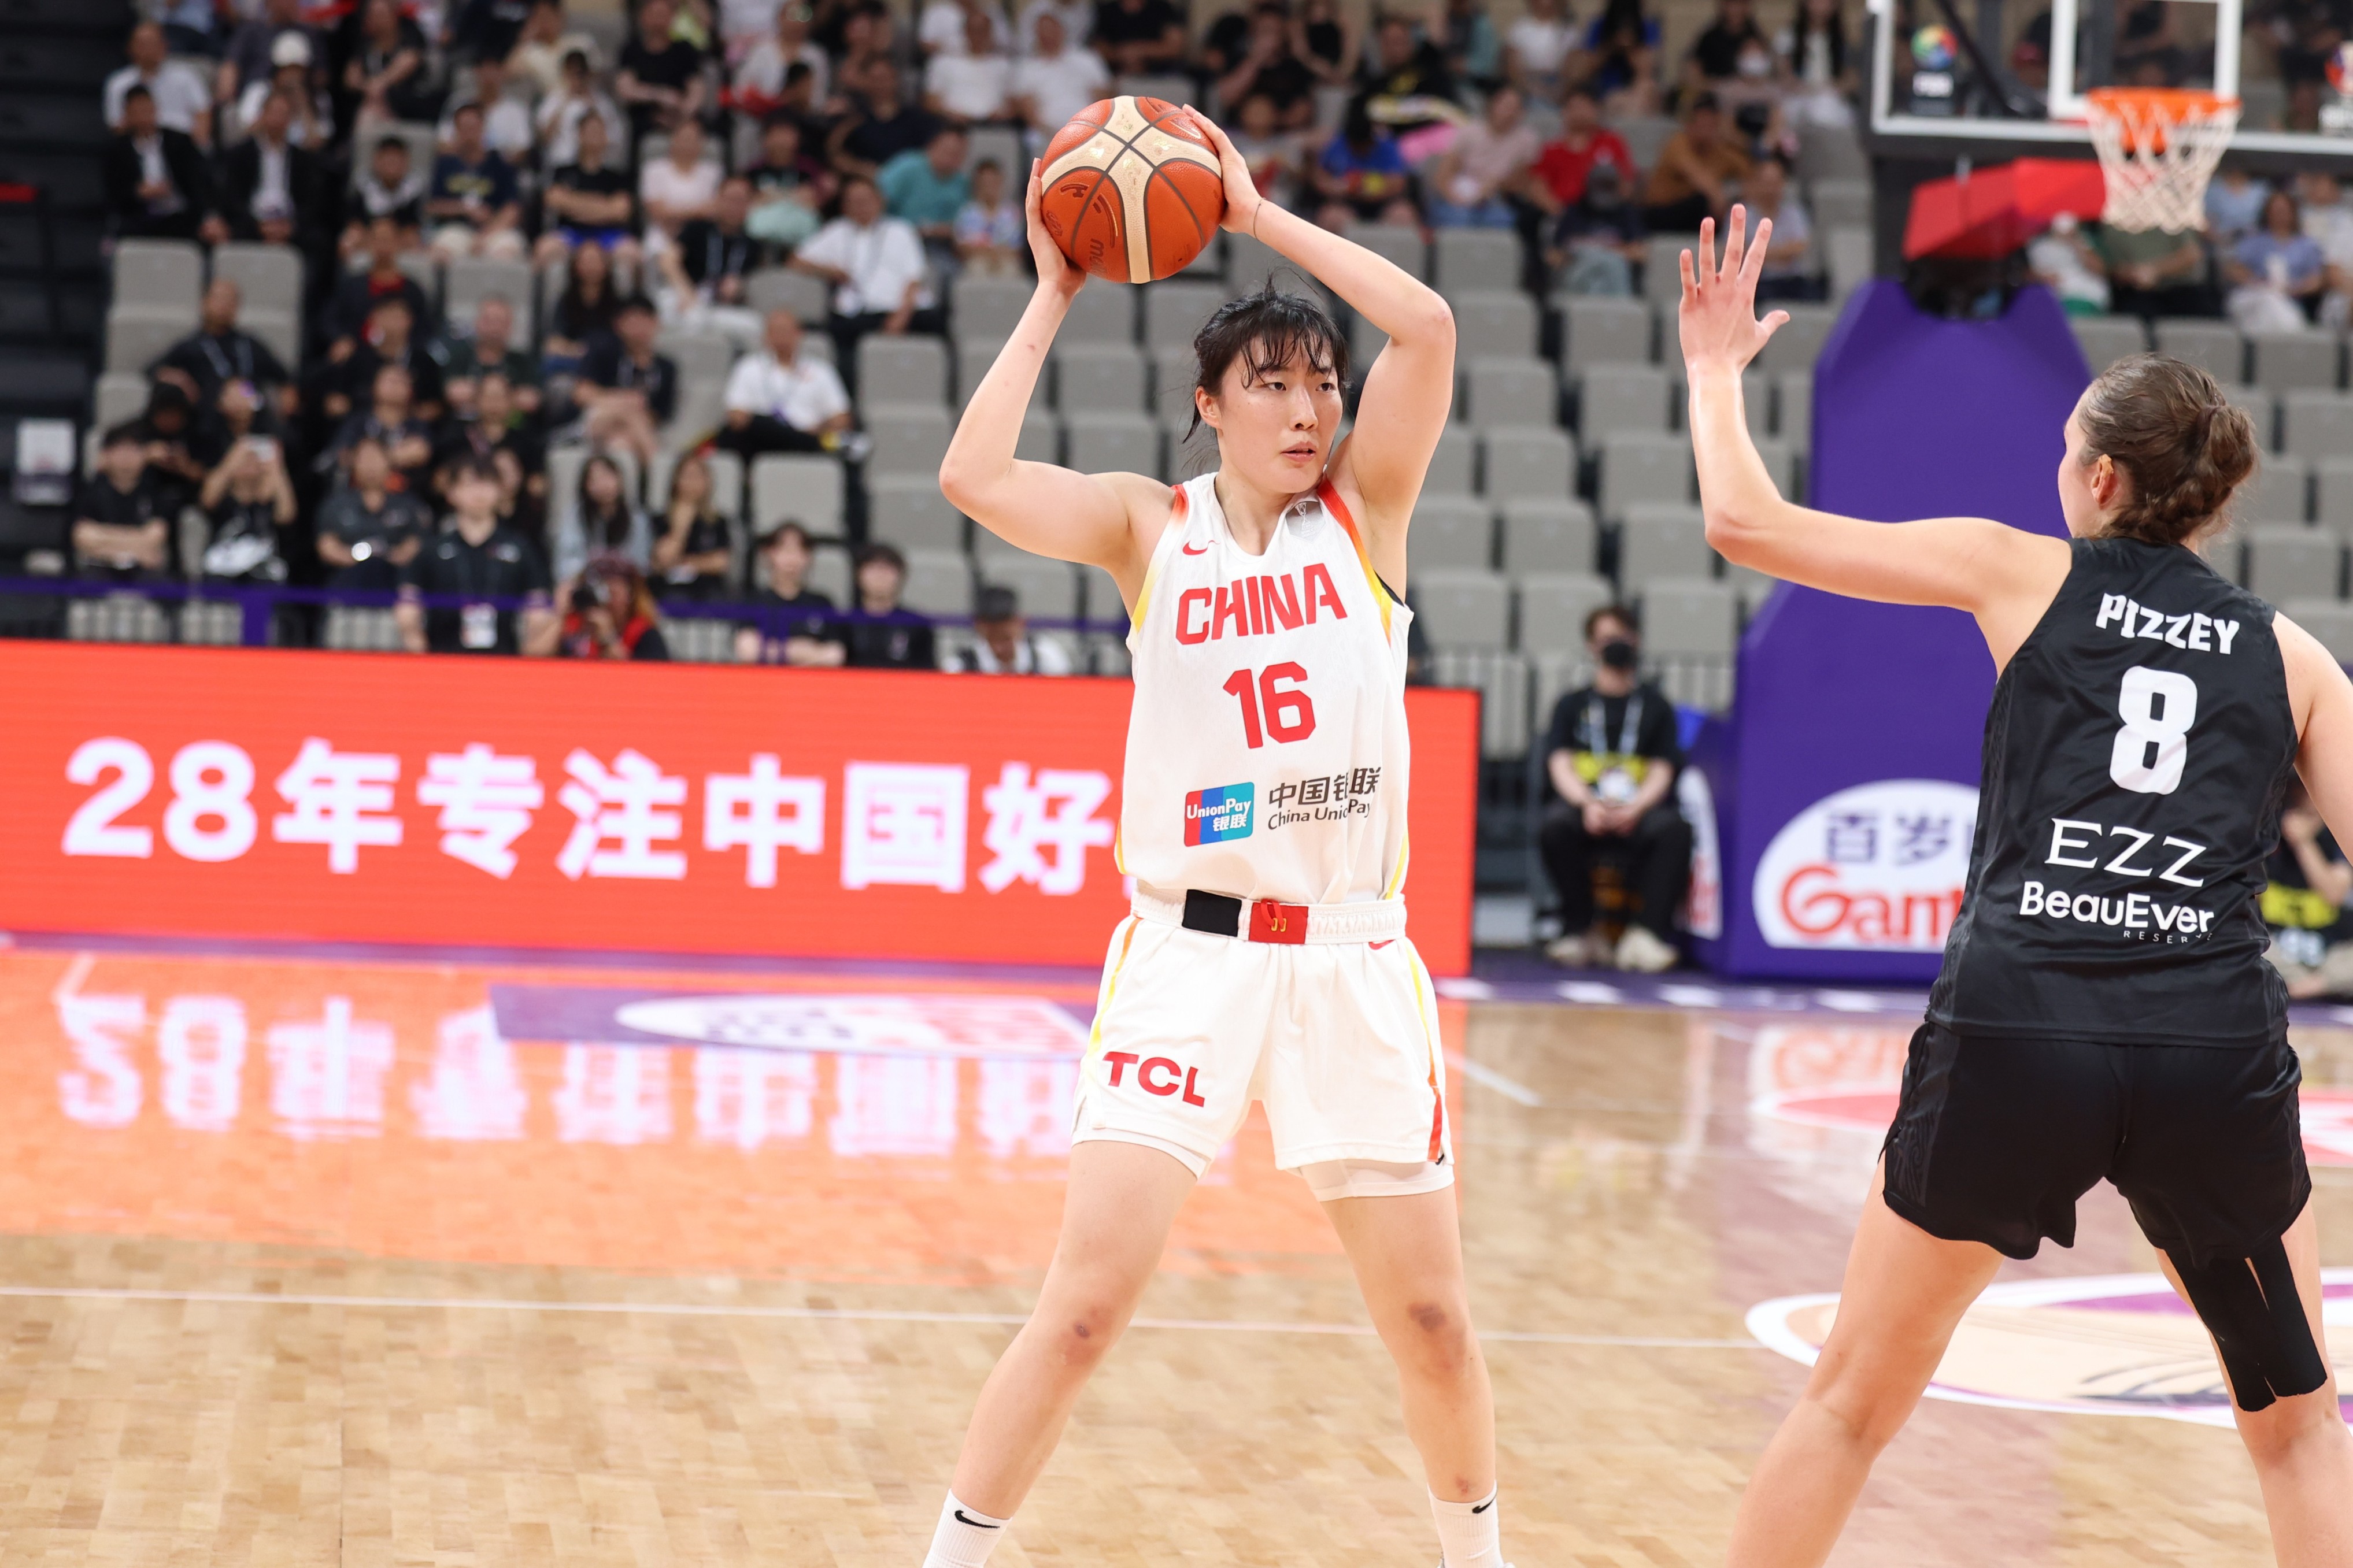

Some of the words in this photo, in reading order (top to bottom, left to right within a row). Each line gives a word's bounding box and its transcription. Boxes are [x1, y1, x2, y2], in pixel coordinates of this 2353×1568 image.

[1175, 563, 1347, 645] CHINA
[2096, 592, 2240, 655] PIZZEY
[1223, 661, 1316, 749] 16
[2110, 665, 2198, 795] 8
[61, 736, 1135, 898] 28年专注中国好
[1187, 798, 1252, 819] UnionPay
[1212, 813, 1247, 832] 银联
[1268, 810, 1309, 830] China
[1826, 812, 1977, 868] 百岁
[2044, 818, 2207, 888] EZZ
[2019, 881, 2214, 933] BeauEver
[1103, 1051, 1205, 1108] TCL
